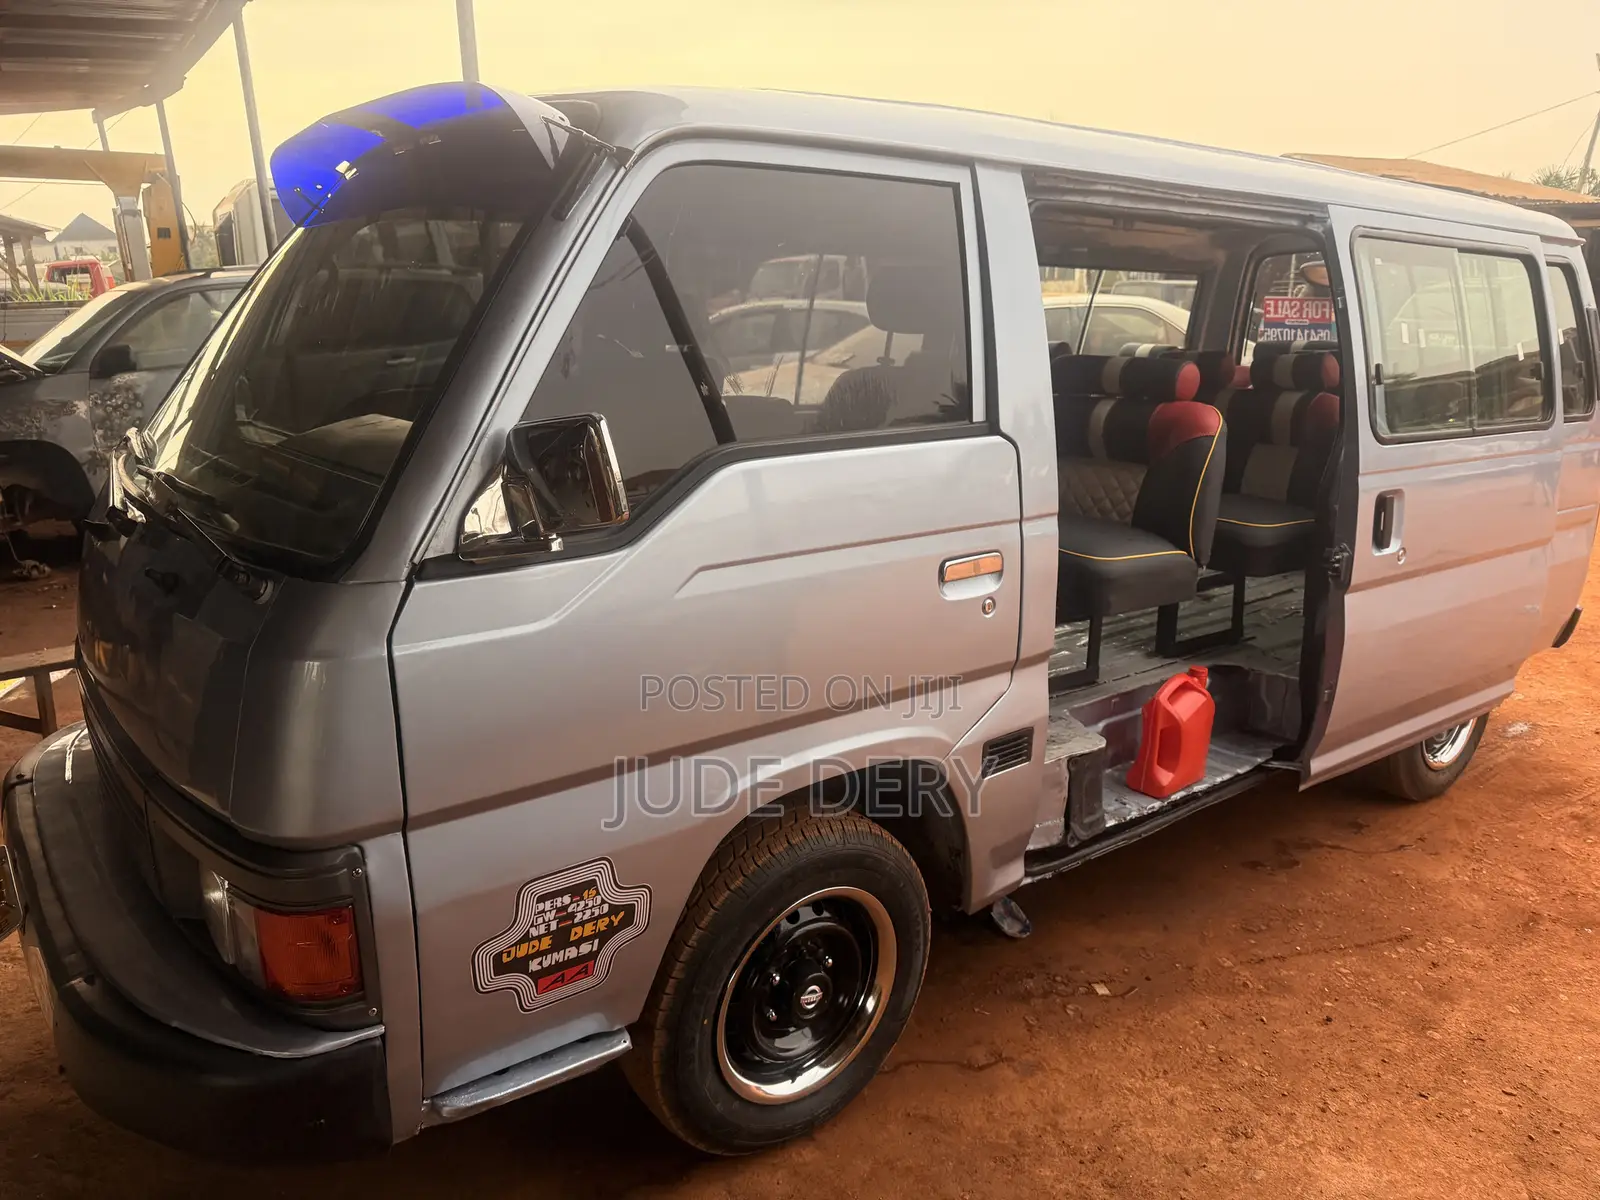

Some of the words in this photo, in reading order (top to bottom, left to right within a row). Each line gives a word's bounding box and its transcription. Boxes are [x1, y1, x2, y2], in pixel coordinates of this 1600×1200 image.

[502, 934, 553, 964] JUDE
[569, 911, 625, 942] DERY
[528, 938, 599, 973] KUMASI
